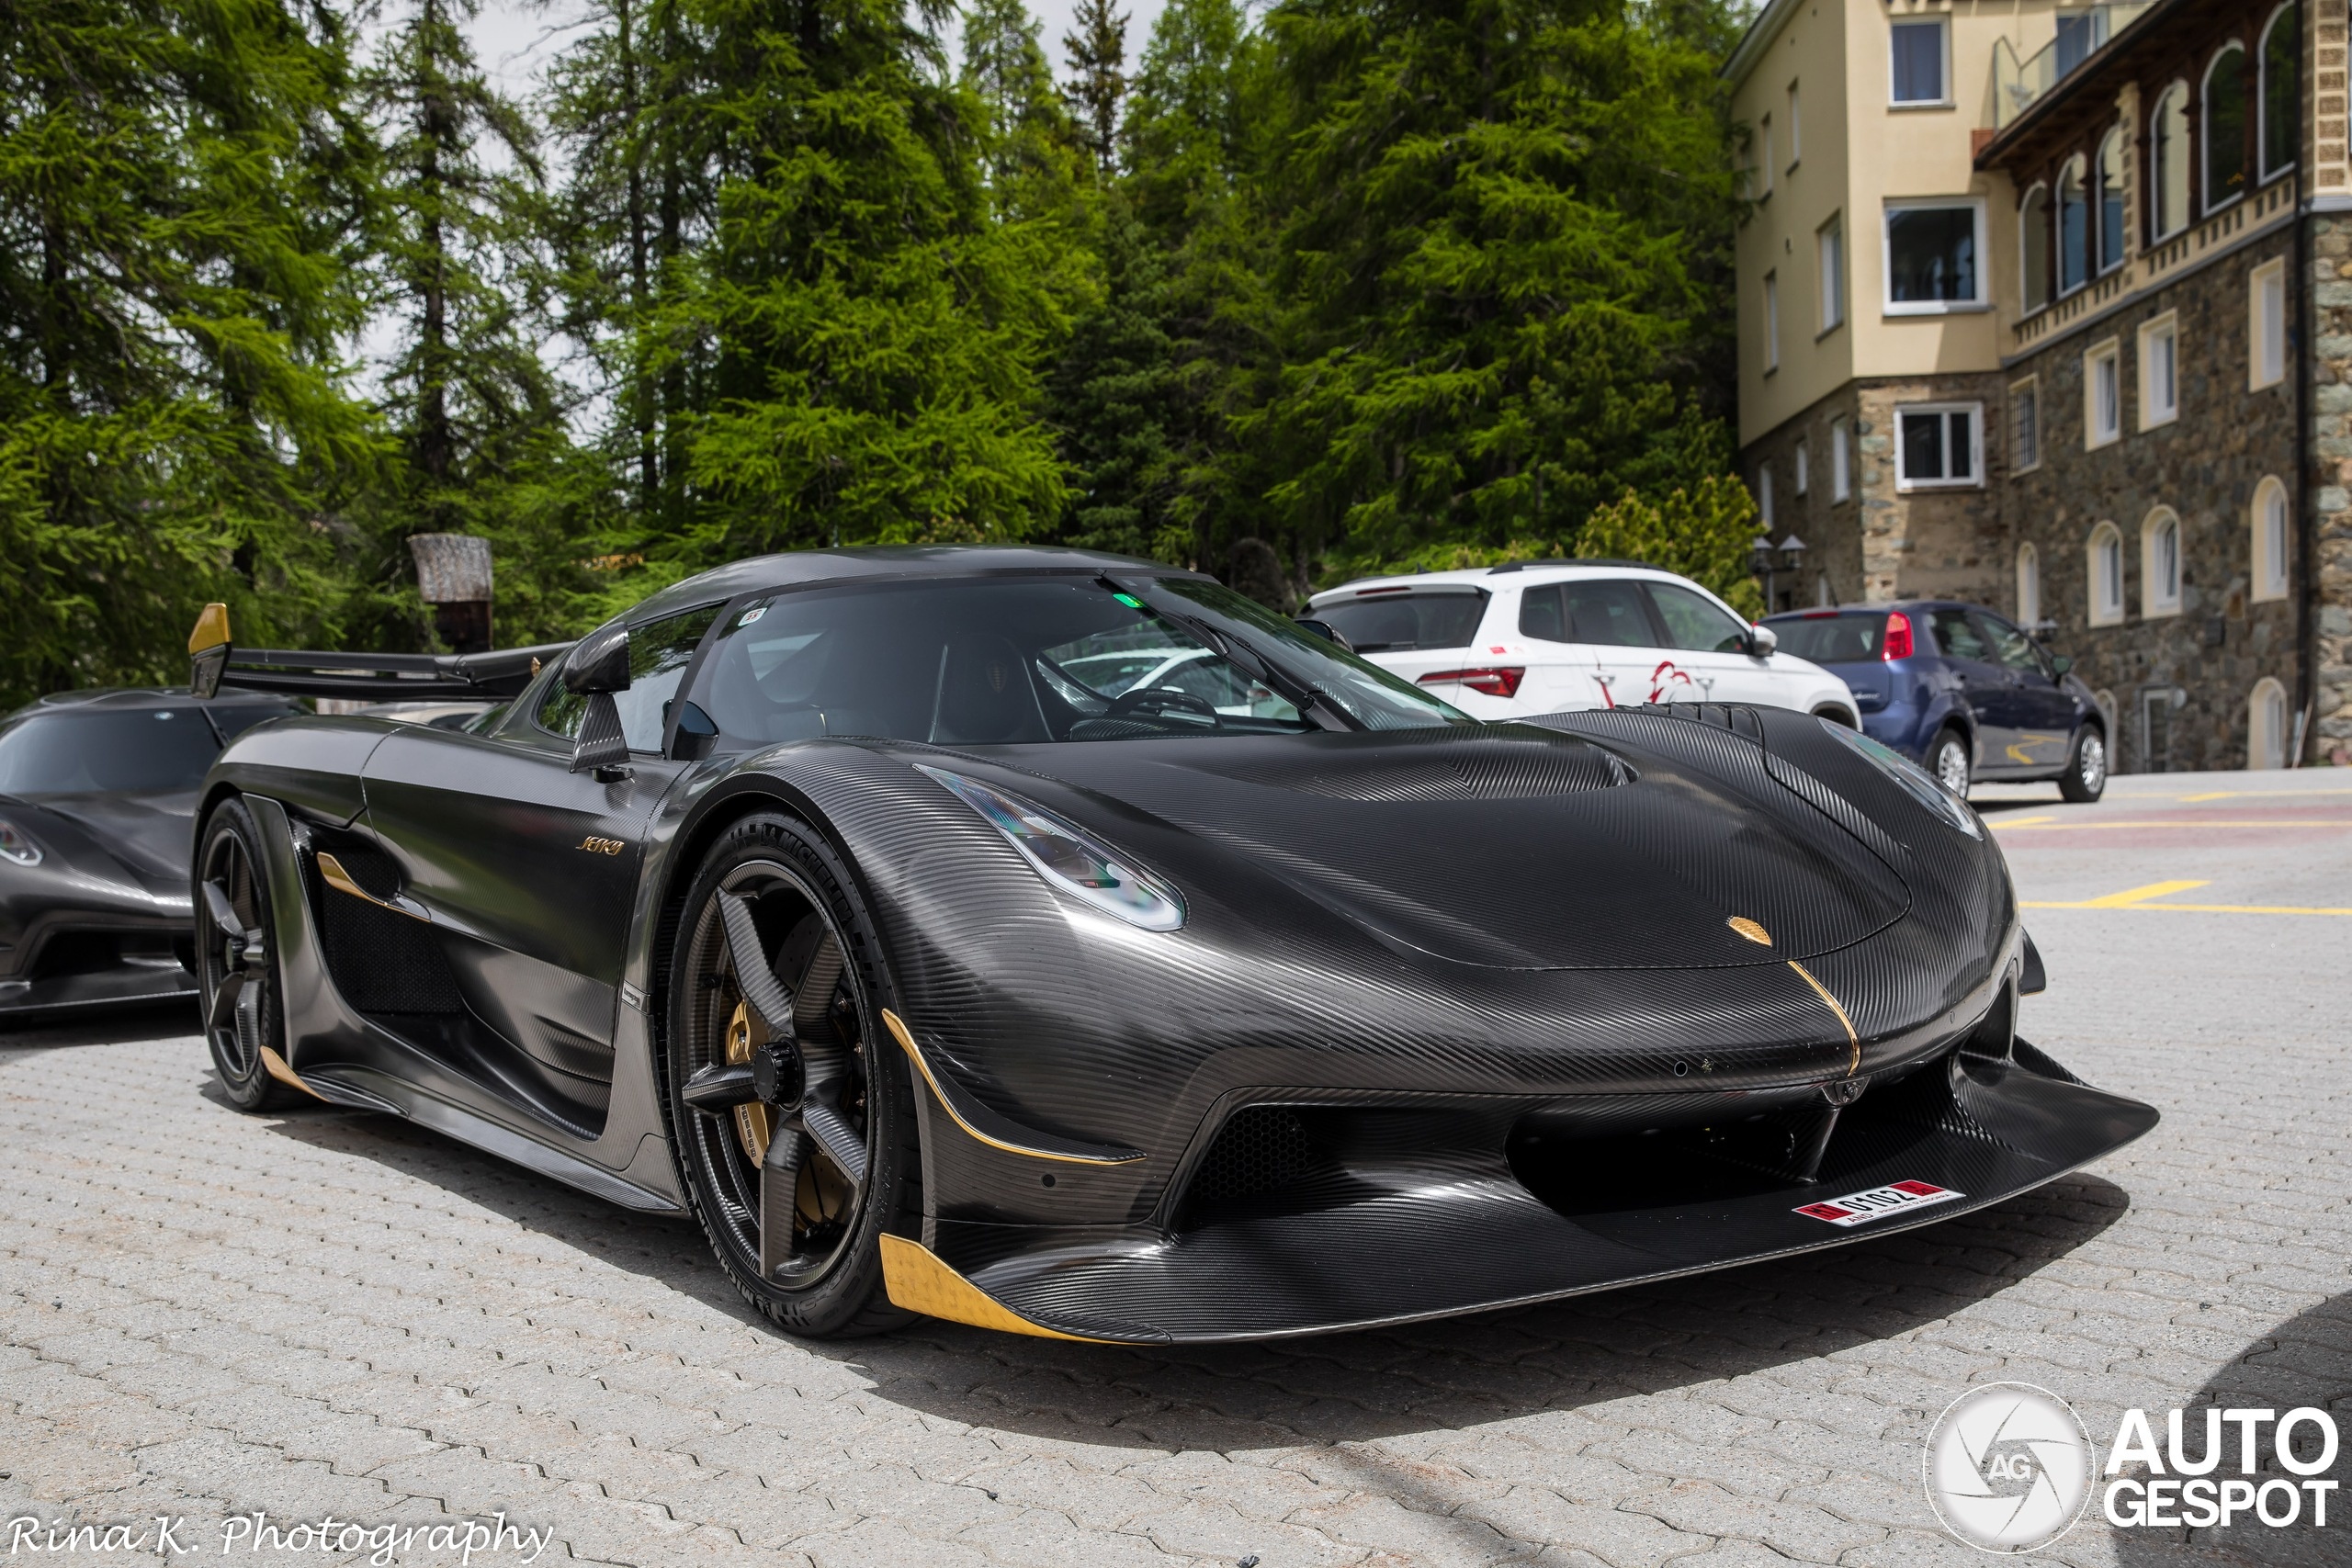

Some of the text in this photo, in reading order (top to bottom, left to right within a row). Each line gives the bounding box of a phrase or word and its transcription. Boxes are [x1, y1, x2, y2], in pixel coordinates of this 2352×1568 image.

[778, 829, 854, 922] MICHELIN
[1838, 1190, 1917, 1212] 0102
[1847, 1213, 1874, 1223] AND
